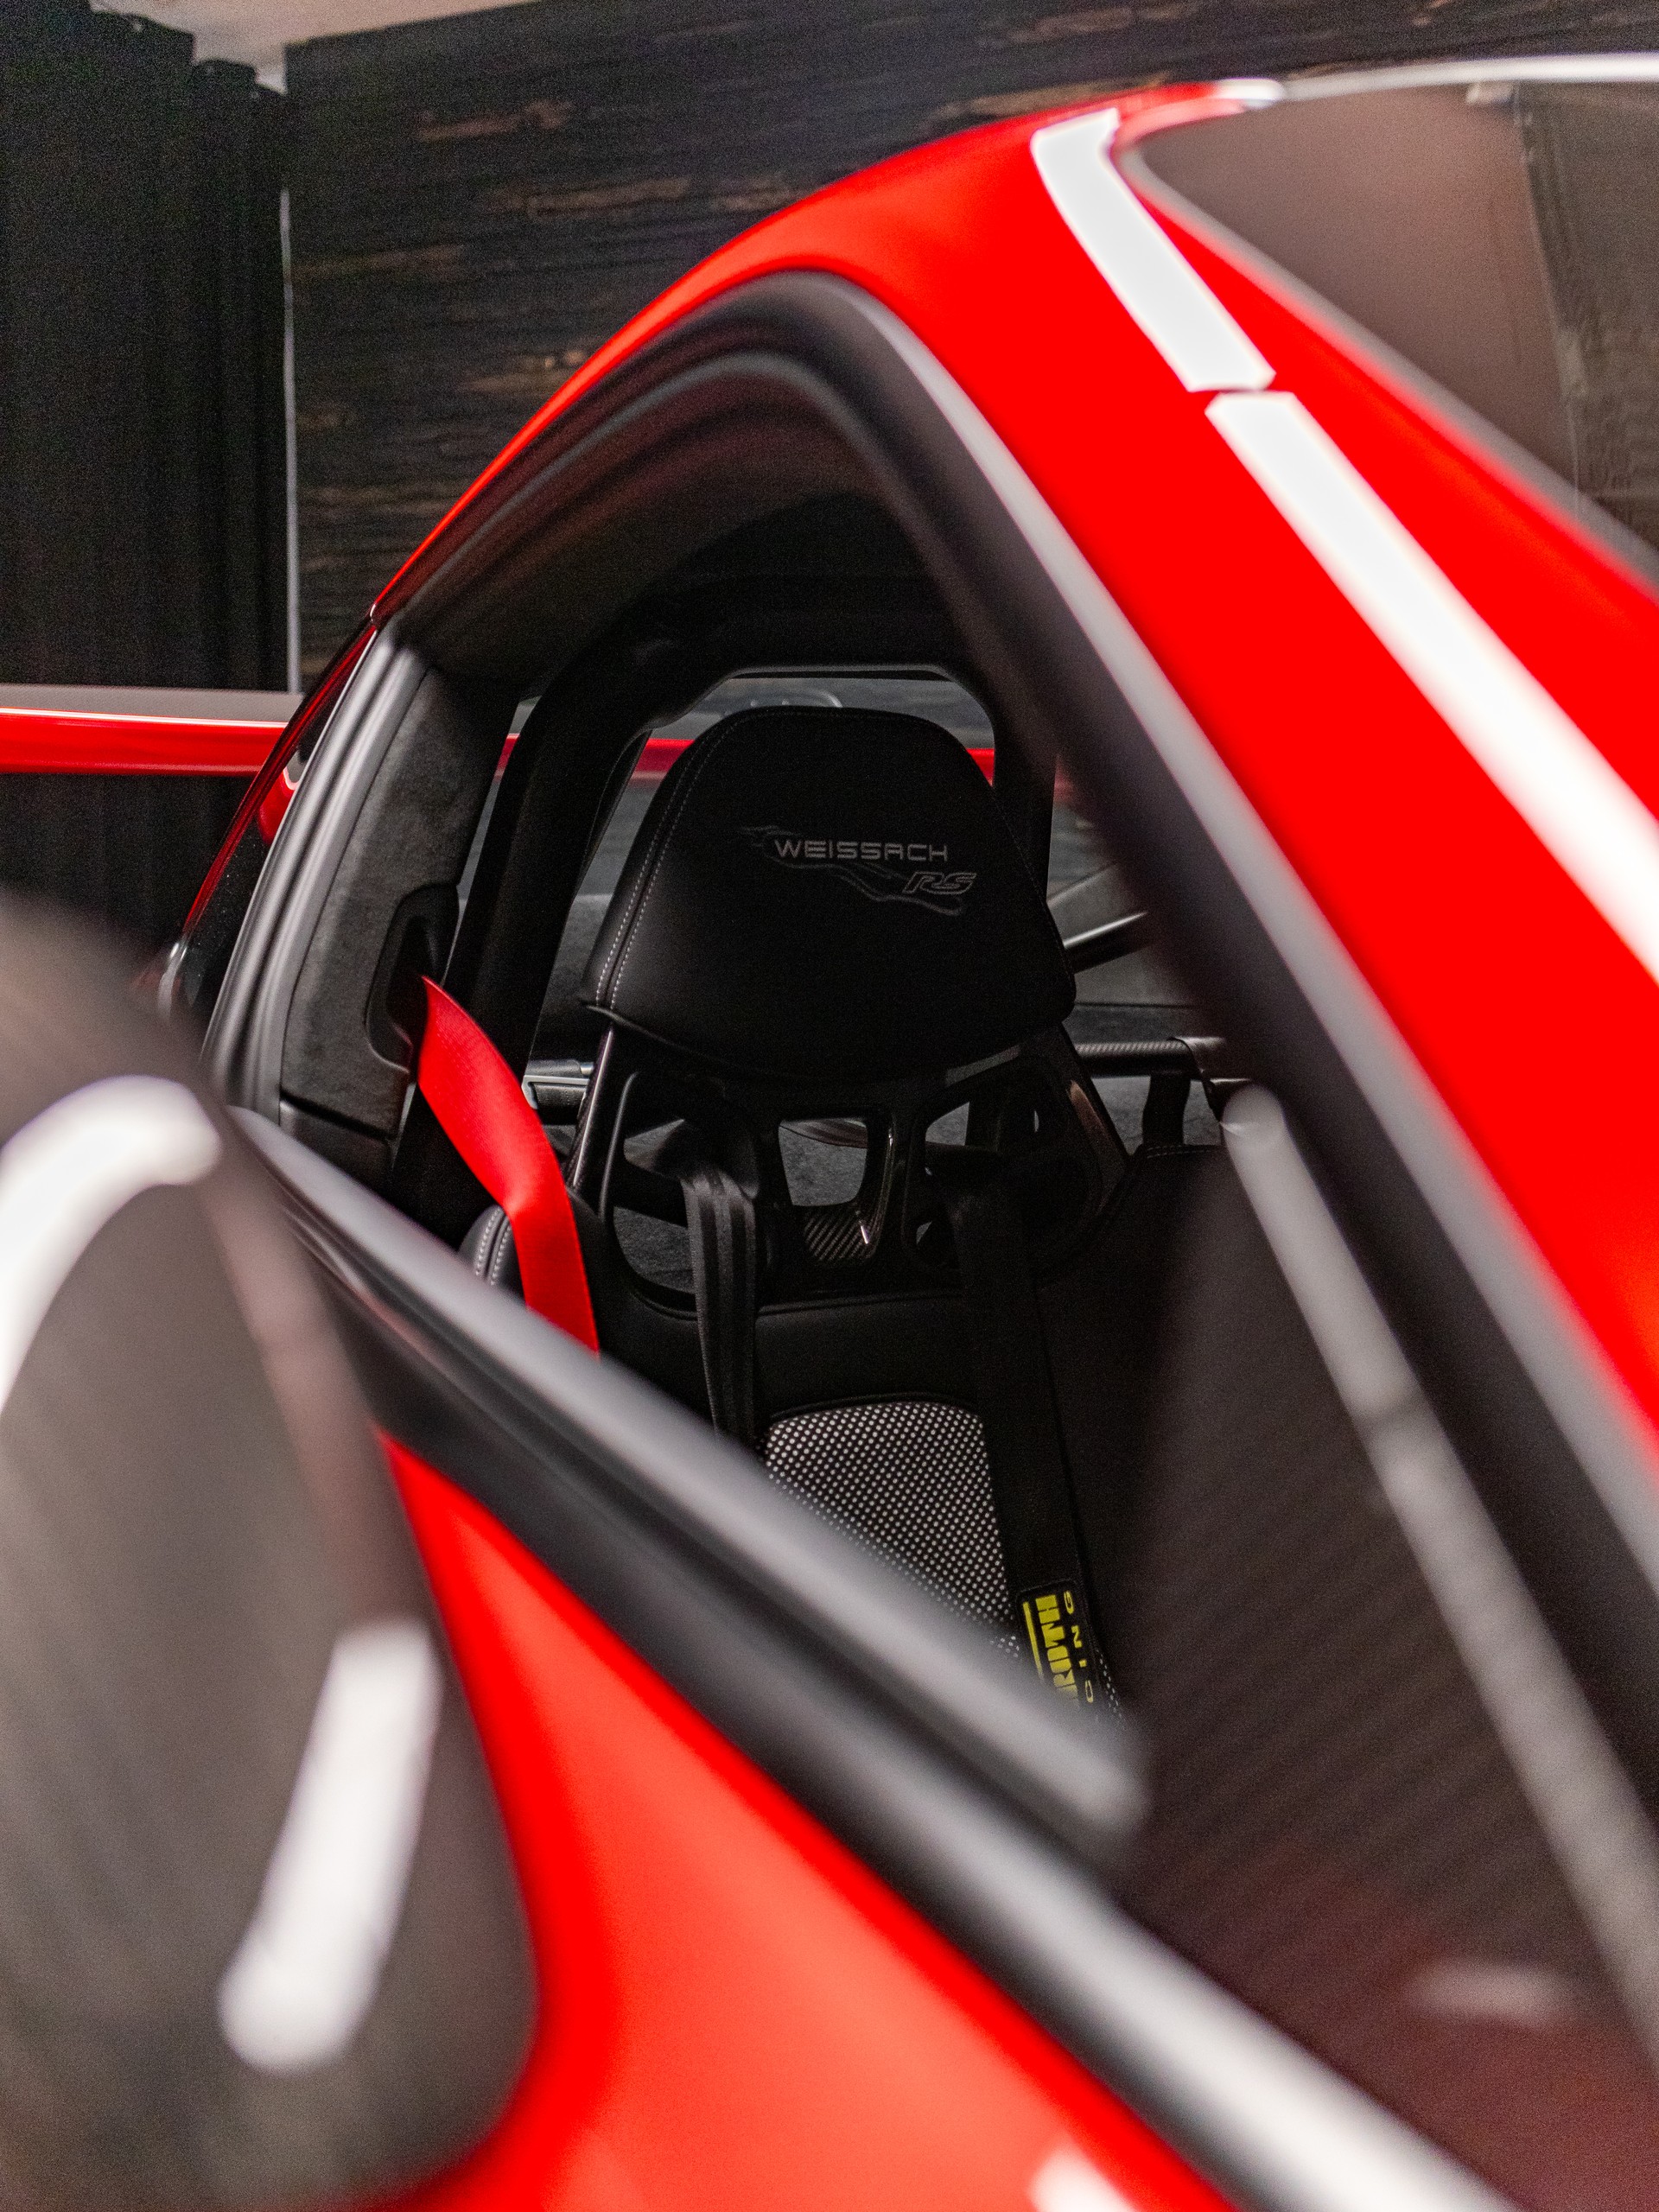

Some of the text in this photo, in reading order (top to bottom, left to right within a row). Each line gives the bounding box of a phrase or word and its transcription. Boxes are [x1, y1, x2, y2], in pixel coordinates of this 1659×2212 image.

[774, 839, 947, 861] WEISSACH
[902, 871, 976, 895] RS
[1035, 1594, 1078, 1704] ROTH
[1064, 1591, 1093, 1704] CING
